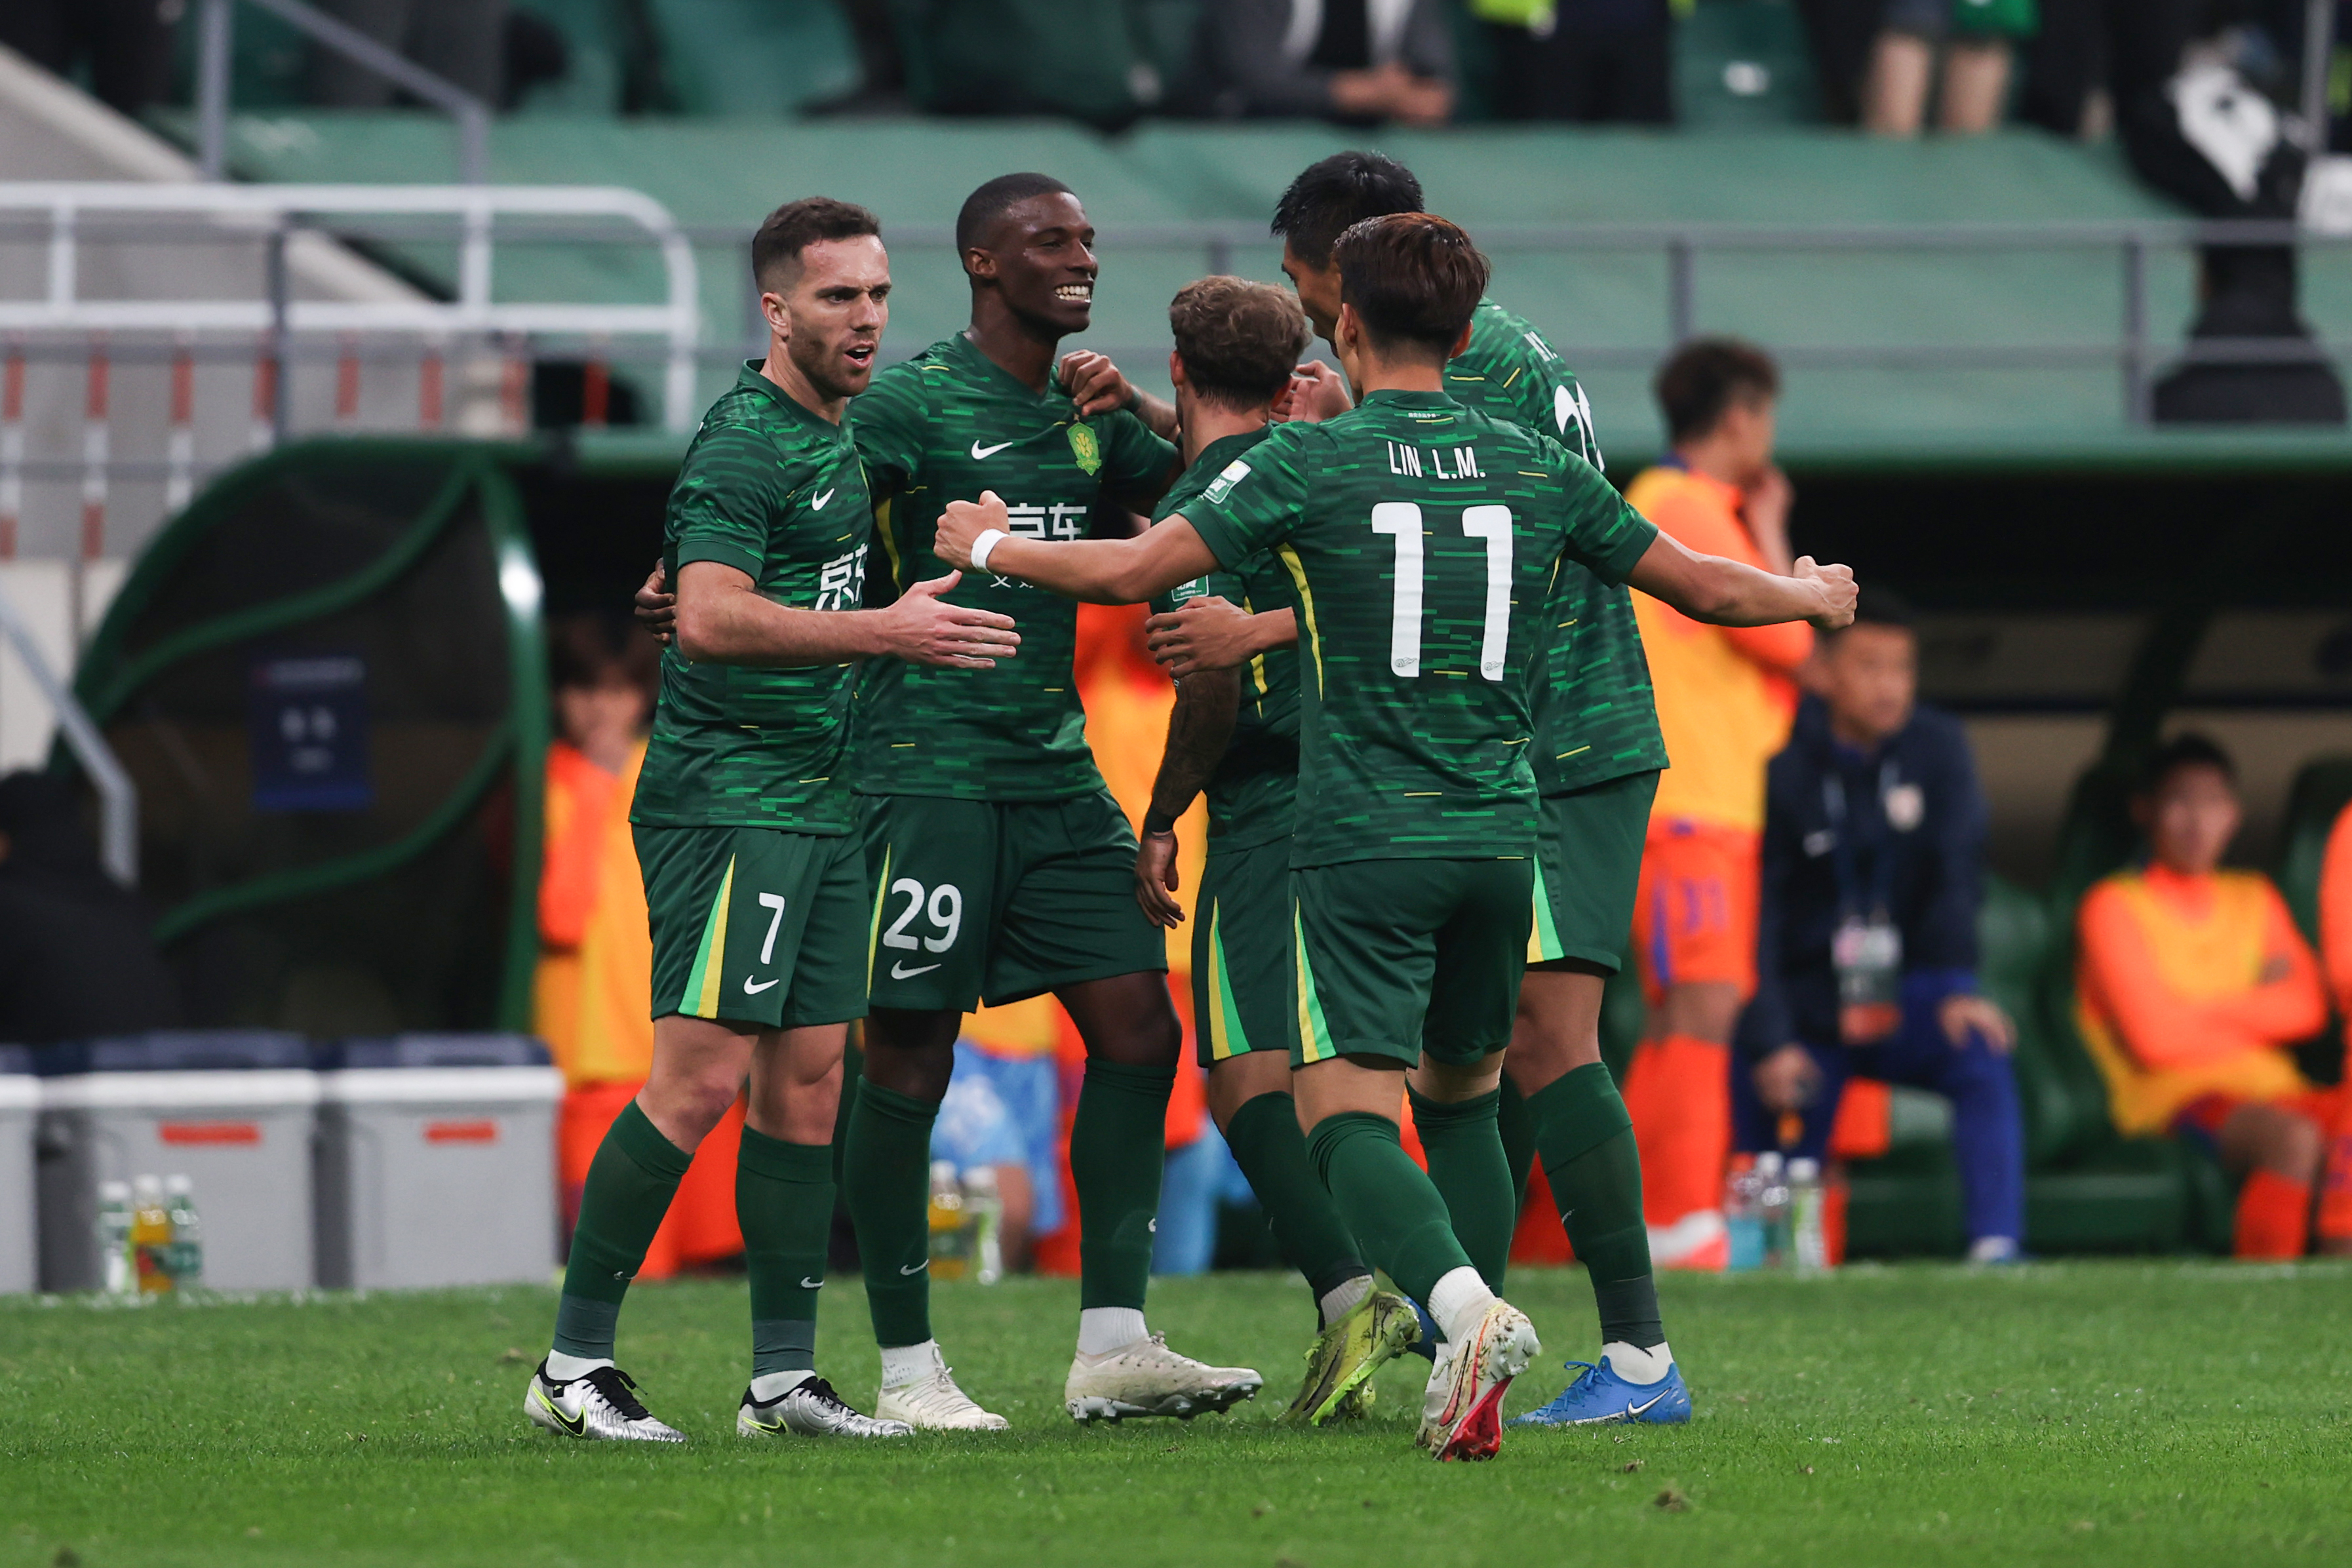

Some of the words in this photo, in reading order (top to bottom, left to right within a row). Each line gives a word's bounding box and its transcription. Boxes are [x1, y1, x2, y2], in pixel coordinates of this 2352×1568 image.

[1387, 441, 1422, 478] LIN
[1432, 446, 1487, 479] L.M.
[1371, 501, 1514, 682] 11
[758, 892, 785, 965] 7
[883, 878, 962, 953] 29
